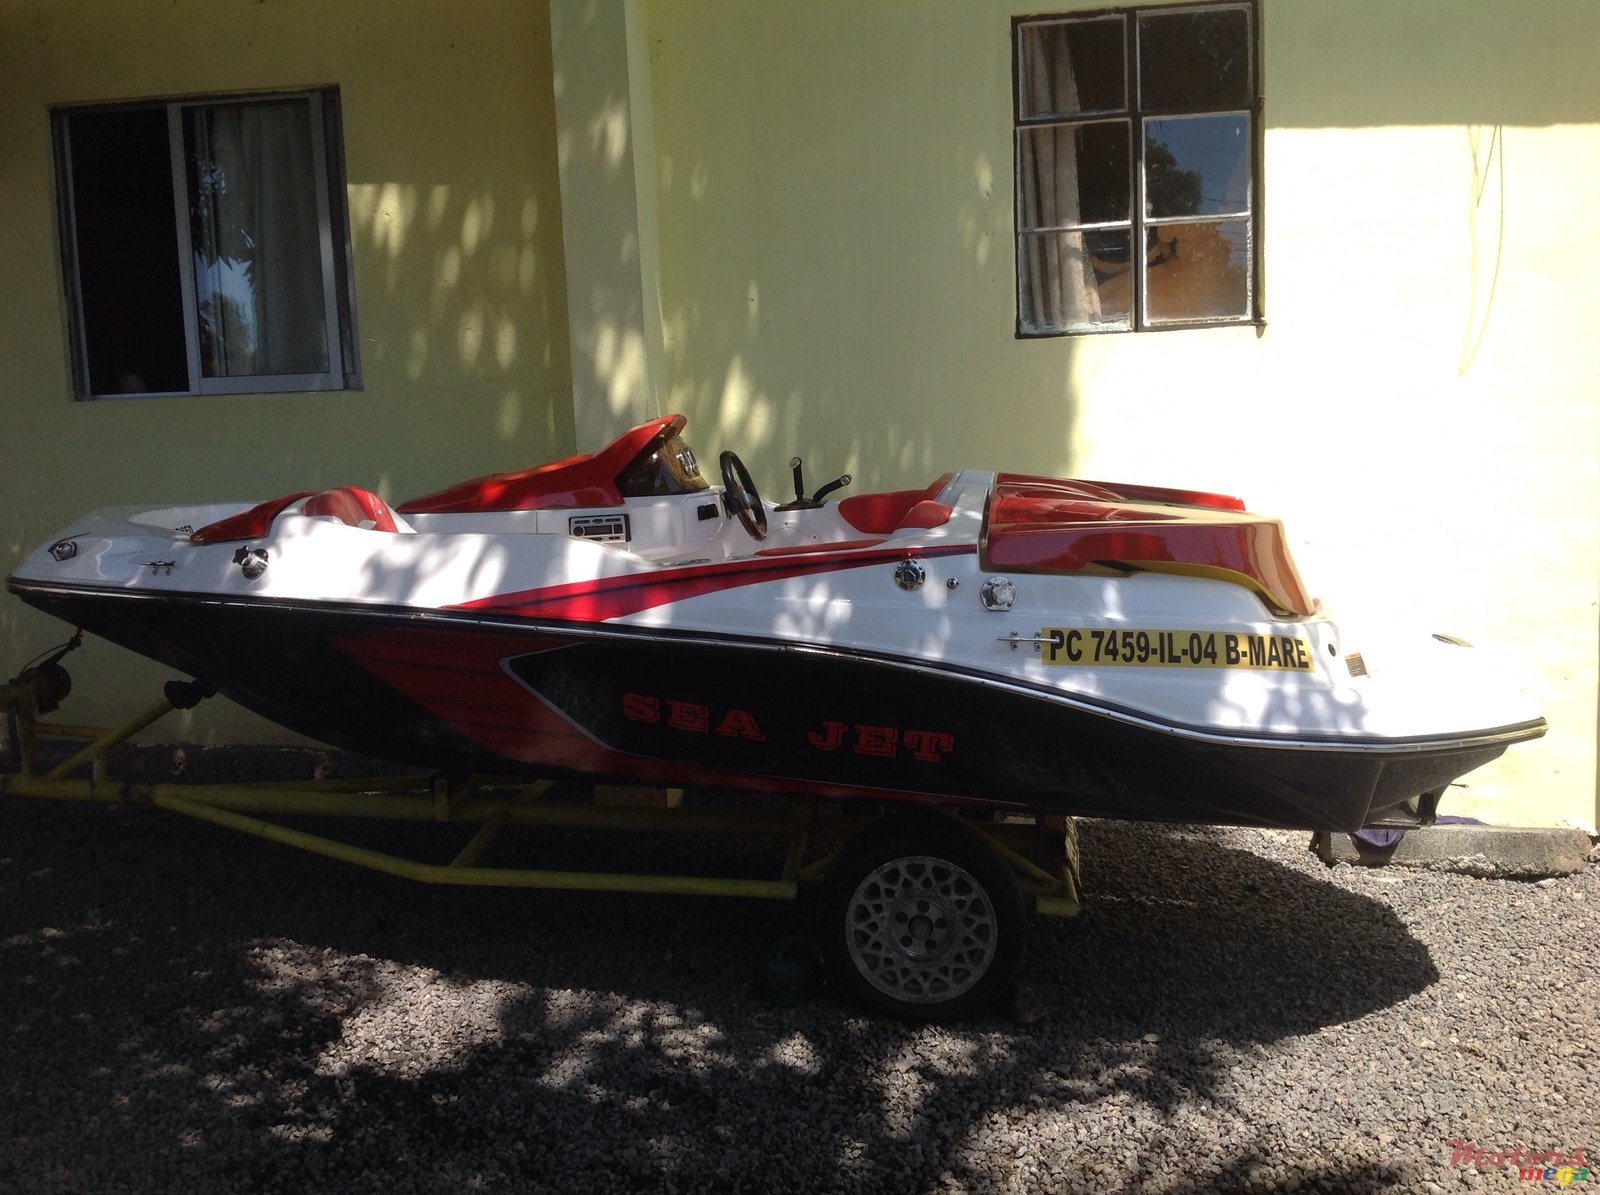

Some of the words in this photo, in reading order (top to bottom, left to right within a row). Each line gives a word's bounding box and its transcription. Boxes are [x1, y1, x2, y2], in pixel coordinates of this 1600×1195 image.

[1050, 629, 1083, 662] PC
[1091, 630, 1217, 665] 7459-IL-04
[1225, 634, 1309, 669] B-MARE
[622, 691, 767, 742] SEA
[806, 720, 955, 763] JET
